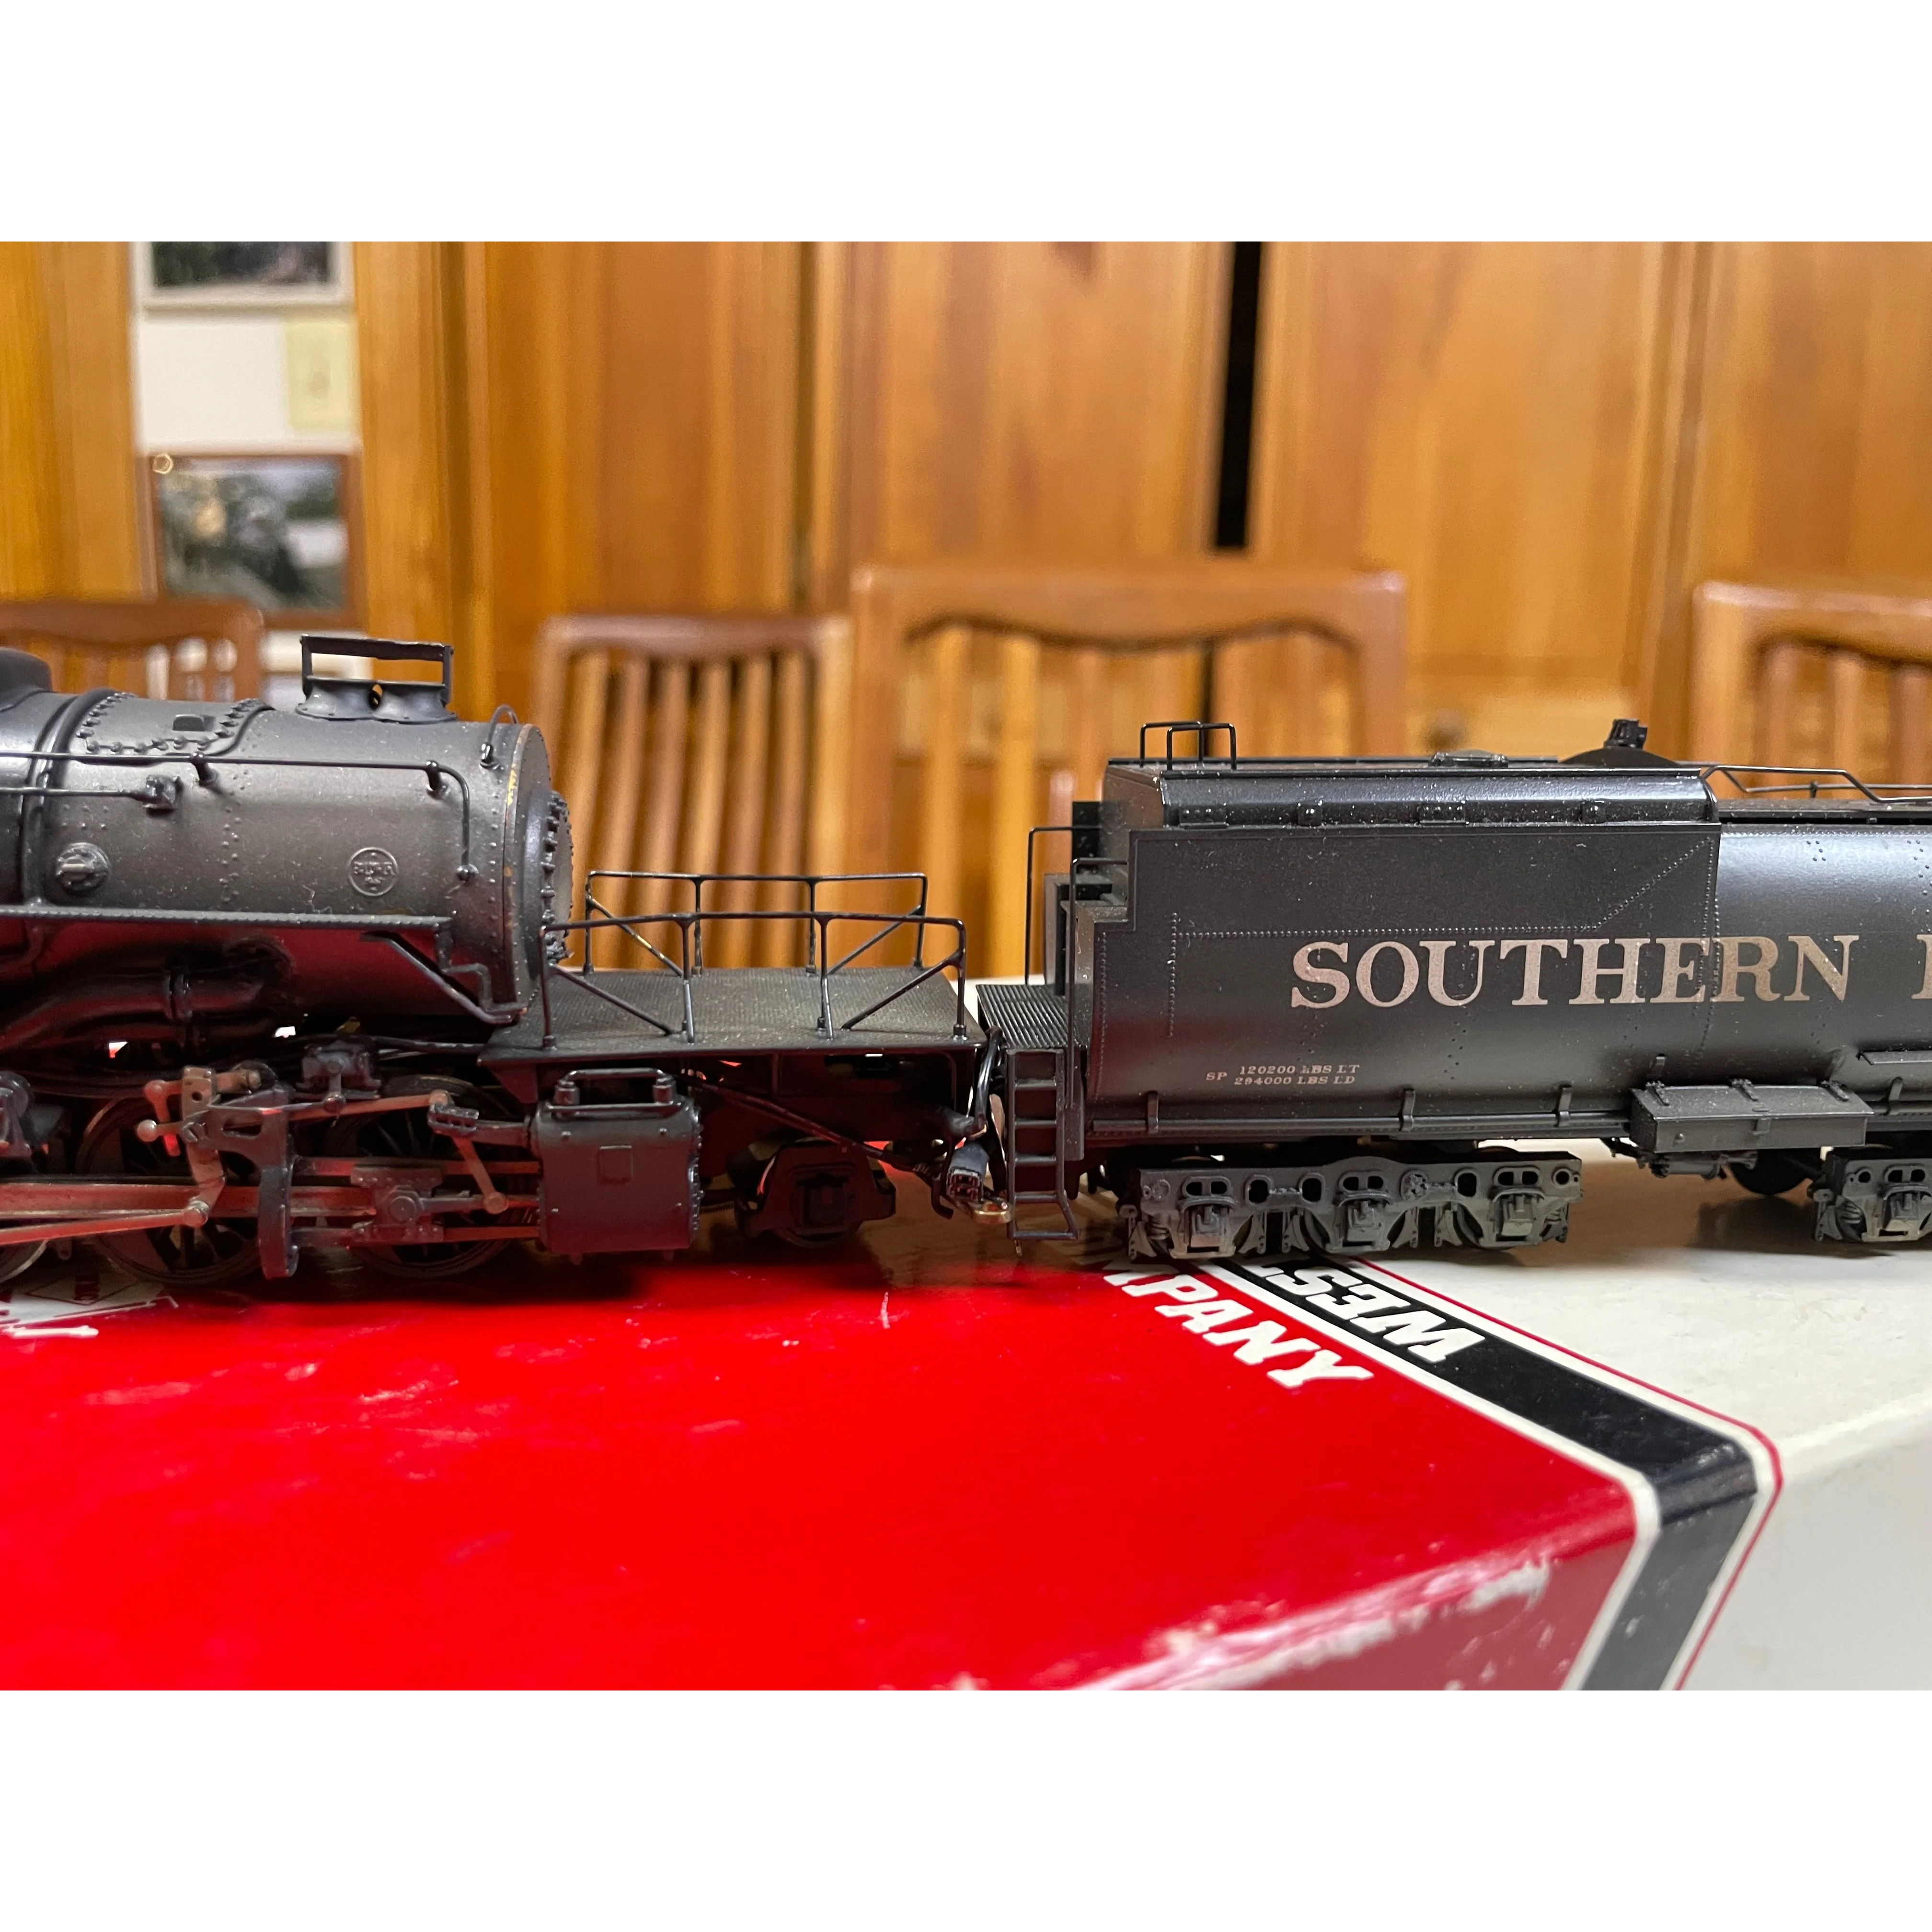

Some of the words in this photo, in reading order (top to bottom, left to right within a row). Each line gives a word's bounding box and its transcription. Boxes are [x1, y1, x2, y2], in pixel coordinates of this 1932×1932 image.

[1291, 934, 1859, 1009] SOUTHERN
[1240, 1065, 1296, 1075] 120200
[1206, 1071, 1228, 1081] SP
[1297, 1076, 1328, 1085] LBS
[1333, 1075, 1355, 1084] LD
